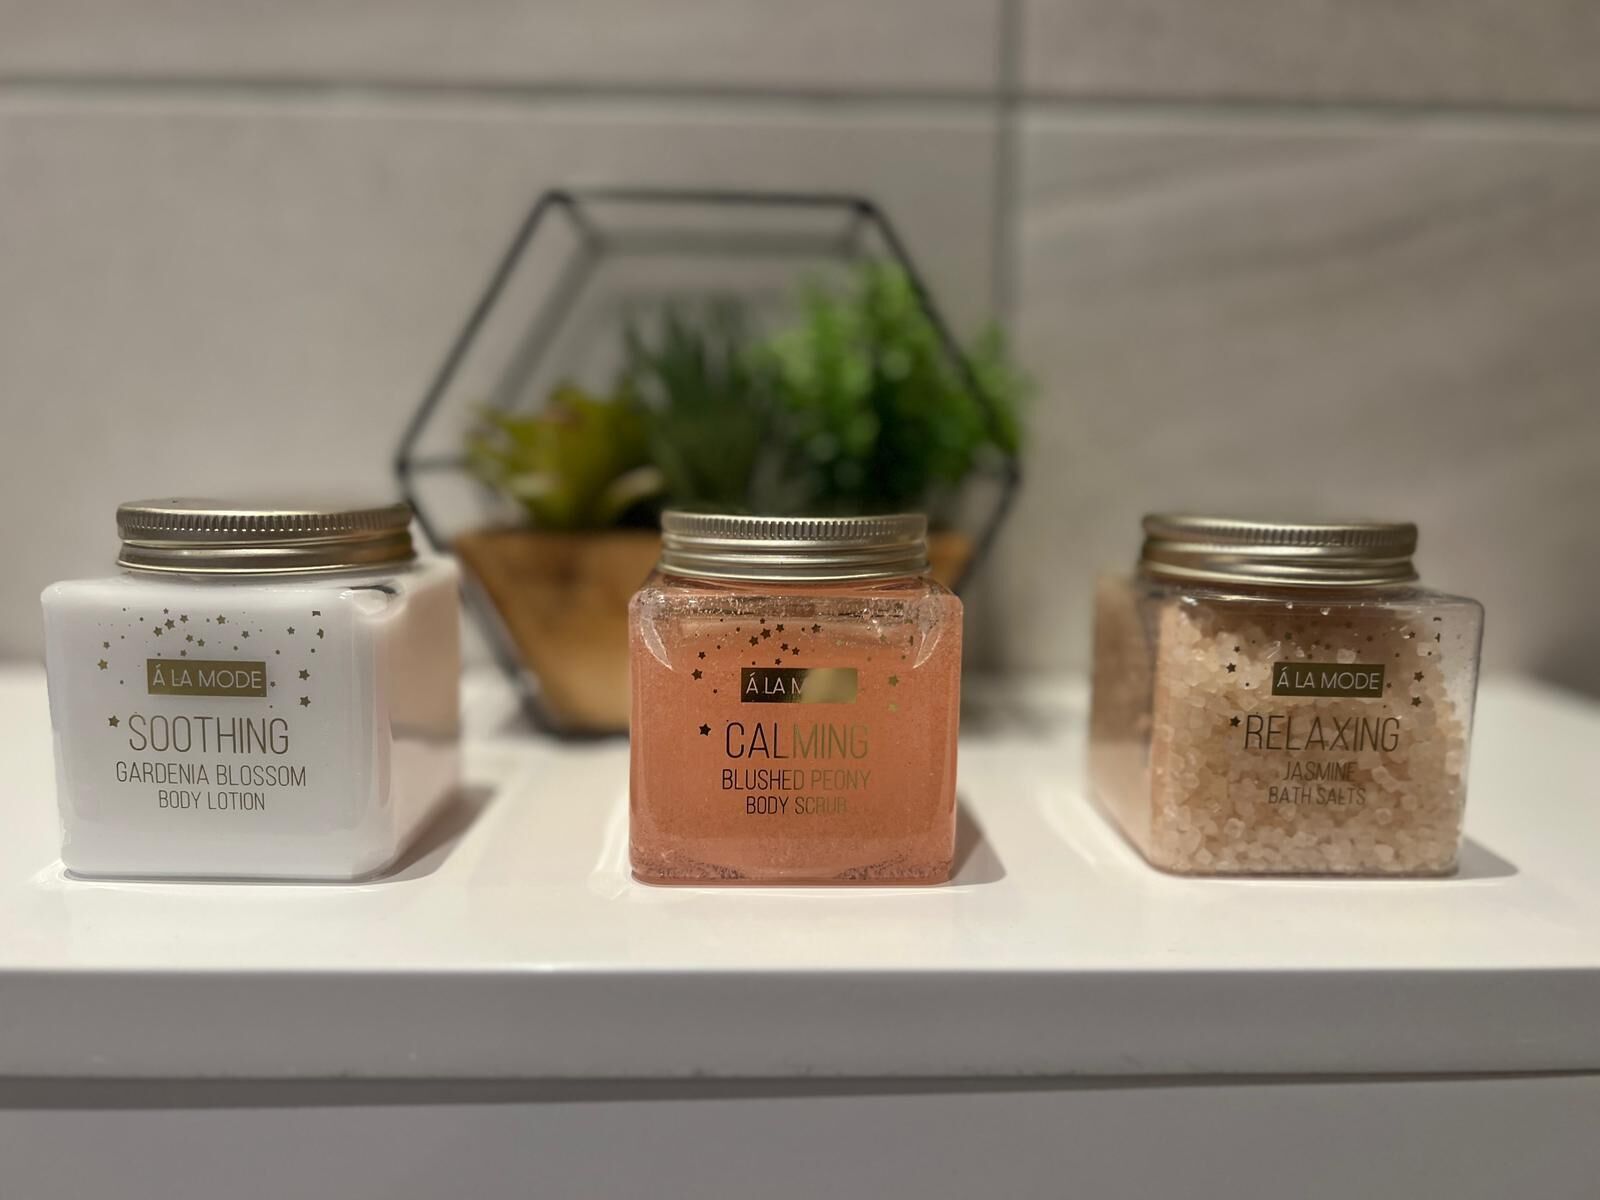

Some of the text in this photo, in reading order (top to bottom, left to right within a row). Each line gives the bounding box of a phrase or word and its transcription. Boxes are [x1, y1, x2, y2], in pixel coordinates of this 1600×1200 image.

[152, 663, 262, 688] Á LA MODE
[745, 671, 759, 694] Á
[764, 677, 786, 694] LA
[1276, 666, 1380, 690] Á LA MODE
[128, 714, 289, 754] SOOTHING
[725, 722, 869, 759] CALMING
[1244, 714, 1400, 752] RELAXING
[116, 761, 306, 787] GARDENIA BLOSSOM
[722, 768, 872, 791] BLUSHED PEONY
[1283, 760, 1358, 782] JASMINE
[158, 789, 265, 811] BODY LOTION
[746, 795, 848, 815] BODY SCRUB
[1268, 786, 1367, 806] BATH SALTS
